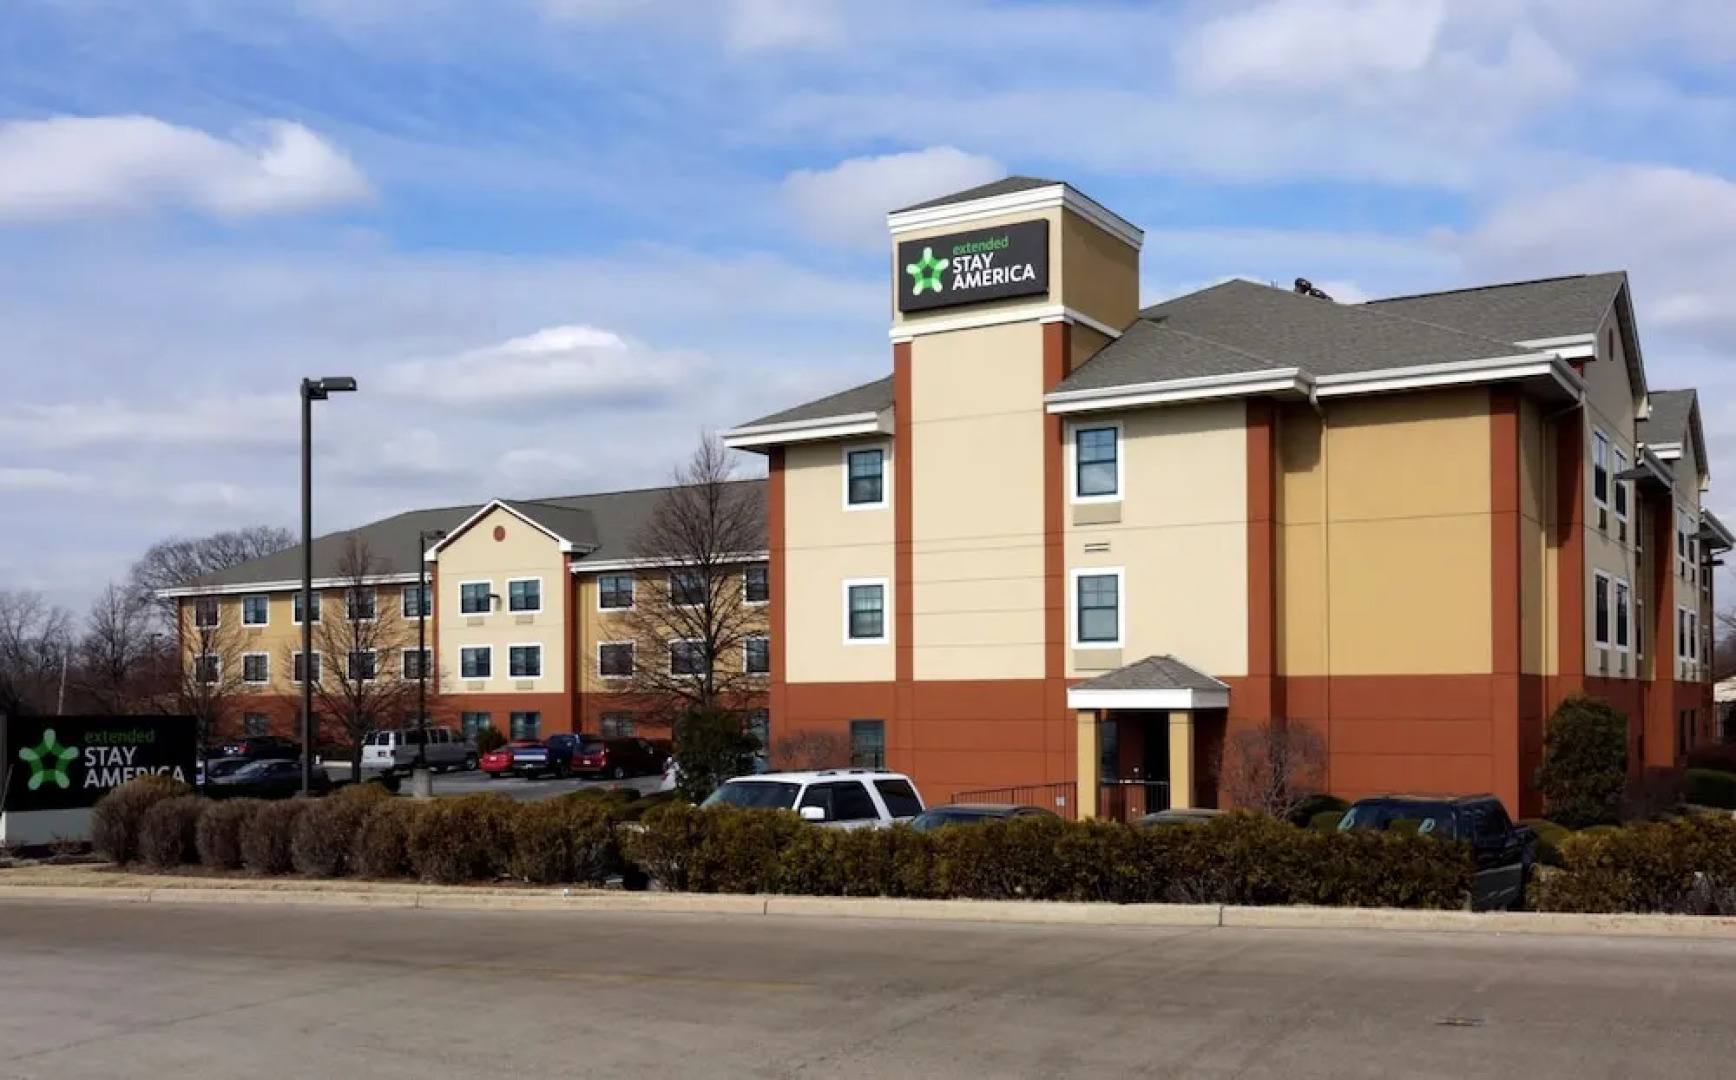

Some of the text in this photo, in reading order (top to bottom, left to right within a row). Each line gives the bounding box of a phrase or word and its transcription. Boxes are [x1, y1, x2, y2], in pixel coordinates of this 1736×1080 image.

[953, 236, 1009, 254] extended
[952, 252, 994, 273] STAY
[952, 263, 1035, 290] AMERICA
[84, 729, 155, 743] extended
[84, 746, 137, 767] STAY
